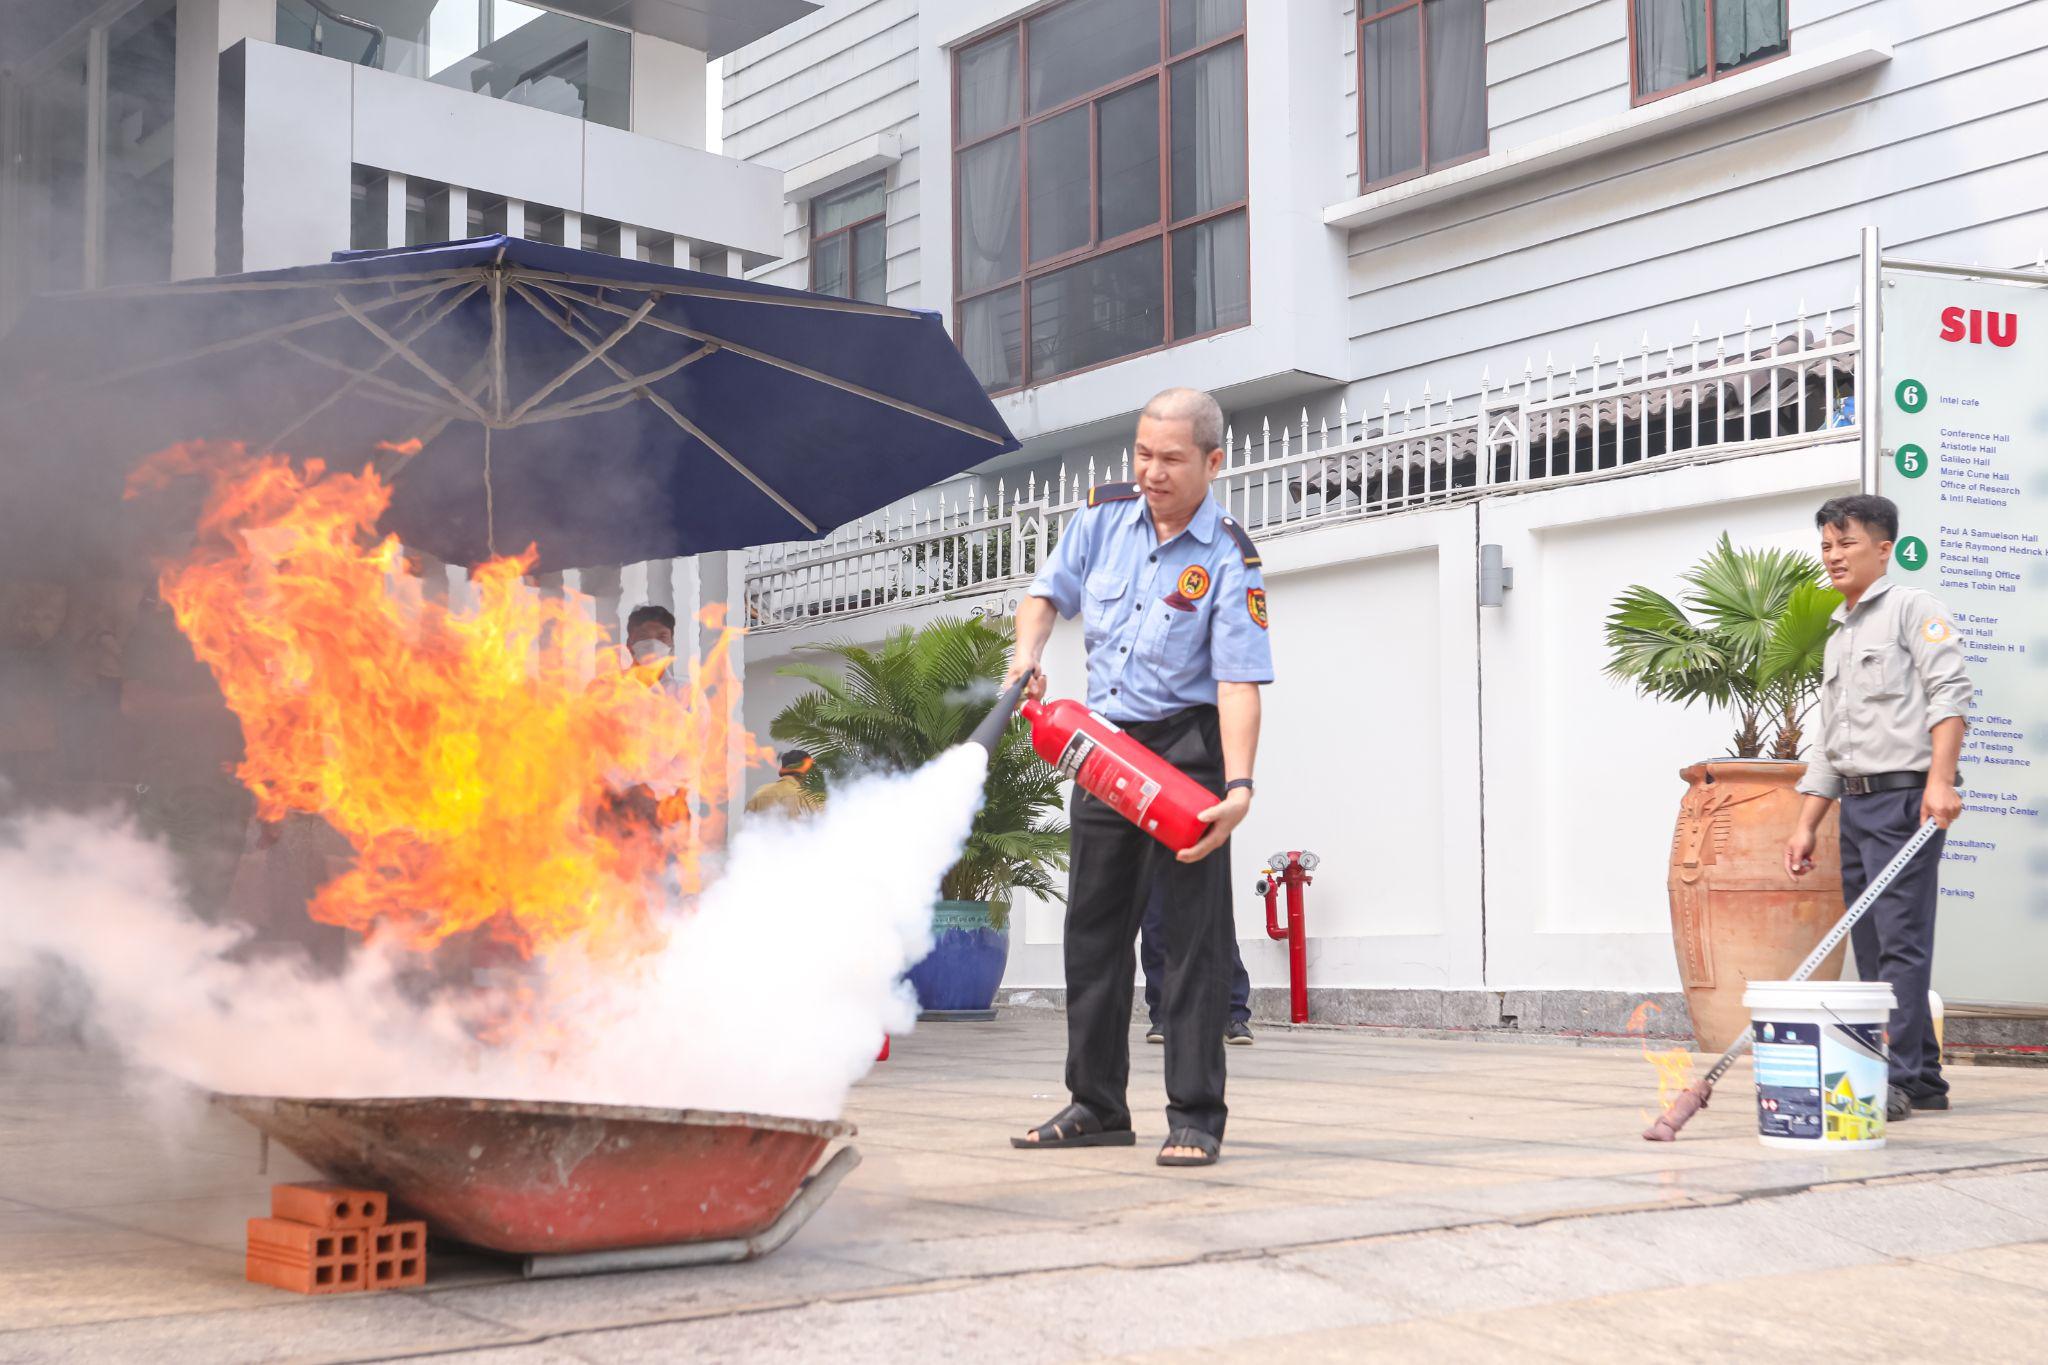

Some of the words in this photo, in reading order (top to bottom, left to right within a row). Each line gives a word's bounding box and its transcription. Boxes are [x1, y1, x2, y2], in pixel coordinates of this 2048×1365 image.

[1939, 306, 2018, 348] SIU
[1903, 386, 1919, 406] 6
[1939, 396, 1959, 405] Intel
[1961, 398, 1980, 407] cafe
[1940, 428, 1991, 441] Conference
[1993, 433, 2010, 443] Hall
[1940, 442, 1977, 453] Aristotle
[1979, 445, 1997, 454] Hall
[1903, 451, 1919, 472] 5
[1940, 454, 1971, 464] Galileo
[1973, 458, 1990, 466] Hall
[1940, 467, 1965, 477] Marie
[1992, 472, 2010, 481] Hall
[1940, 480, 1966, 490] Office
[1968, 483, 1977, 491] of
[1979, 483, 2021, 495] Research
[1940, 493, 1947, 501] &
[1966, 495, 2007, 507] Relations
[1940, 526, 1959, 536] Paul
[1962, 528, 1968, 536] A
[1970, 528, 2019, 541] Samuelson
[2021, 533, 2039, 542] Hall
[1902, 541, 1918, 562] 4
[1940, 539, 1963, 549] Earle
[1965, 541, 2007, 553] Raymond
[2009, 546, 2043, 556] Hedrick
[1940, 552, 1969, 563] Pascal
[1972, 555, 1989, 564] Hall
[1940, 566, 1992, 579] Counselling
[1995, 570, 2021, 580] Office
[1940, 579, 1968, 589] James
[1971, 581, 1996, 591] Tobin
[1998, 584, 2016, 593] Hall
[1953, 613, 1966, 621] EM
[1968, 614, 1998, 624] Center
[1976, 629, 1993, 637] Hall
[1970, 640, 2005, 651] Einstein
[1963, 654, 1988, 663] cellor
[1986, 715, 2012, 725] Office
[1973, 728, 2023, 740] Conference
[1969, 741, 1978, 749] of
[1980, 742, 2013, 753] Testing
[1957, 754, 1981, 765] uality
[1984, 755, 2031, 767] Assurance
[1969, 790, 1998, 801] Dewey
[2001, 793, 2018, 801] Lab
[1961, 803, 2007, 815] Armstrong
[2010, 806, 2039, 816] Center
[1940, 851, 1977, 862] eLibrary
[1940, 887, 1975, 899] Parking
